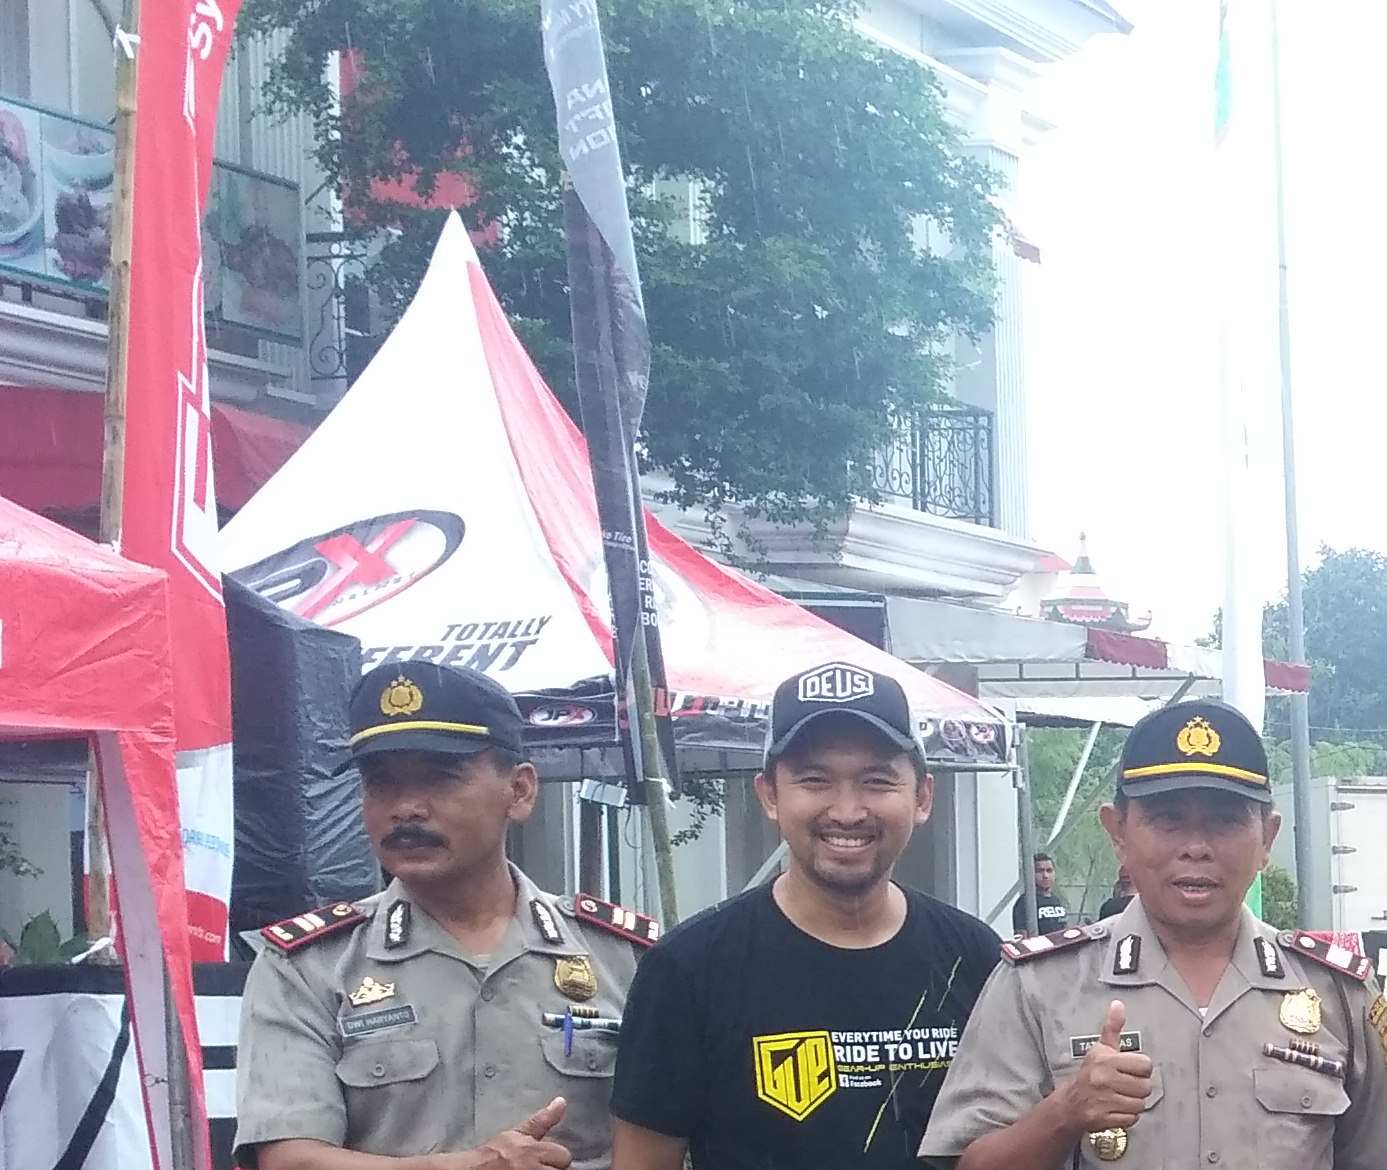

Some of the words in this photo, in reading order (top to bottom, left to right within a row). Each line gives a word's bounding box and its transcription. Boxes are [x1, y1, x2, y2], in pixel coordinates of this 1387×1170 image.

[440, 615, 553, 642] TOTALLY
[831, 1031, 902, 1043] EVERYTIME
[903, 1028, 930, 1041] YOU
[932, 1027, 958, 1039] RIDE
[835, 1045, 881, 1063] RIDE
[885, 1044, 914, 1061] TO
[917, 1040, 958, 1059] LIVE
[849, 1078, 883, 1088] Facebook
